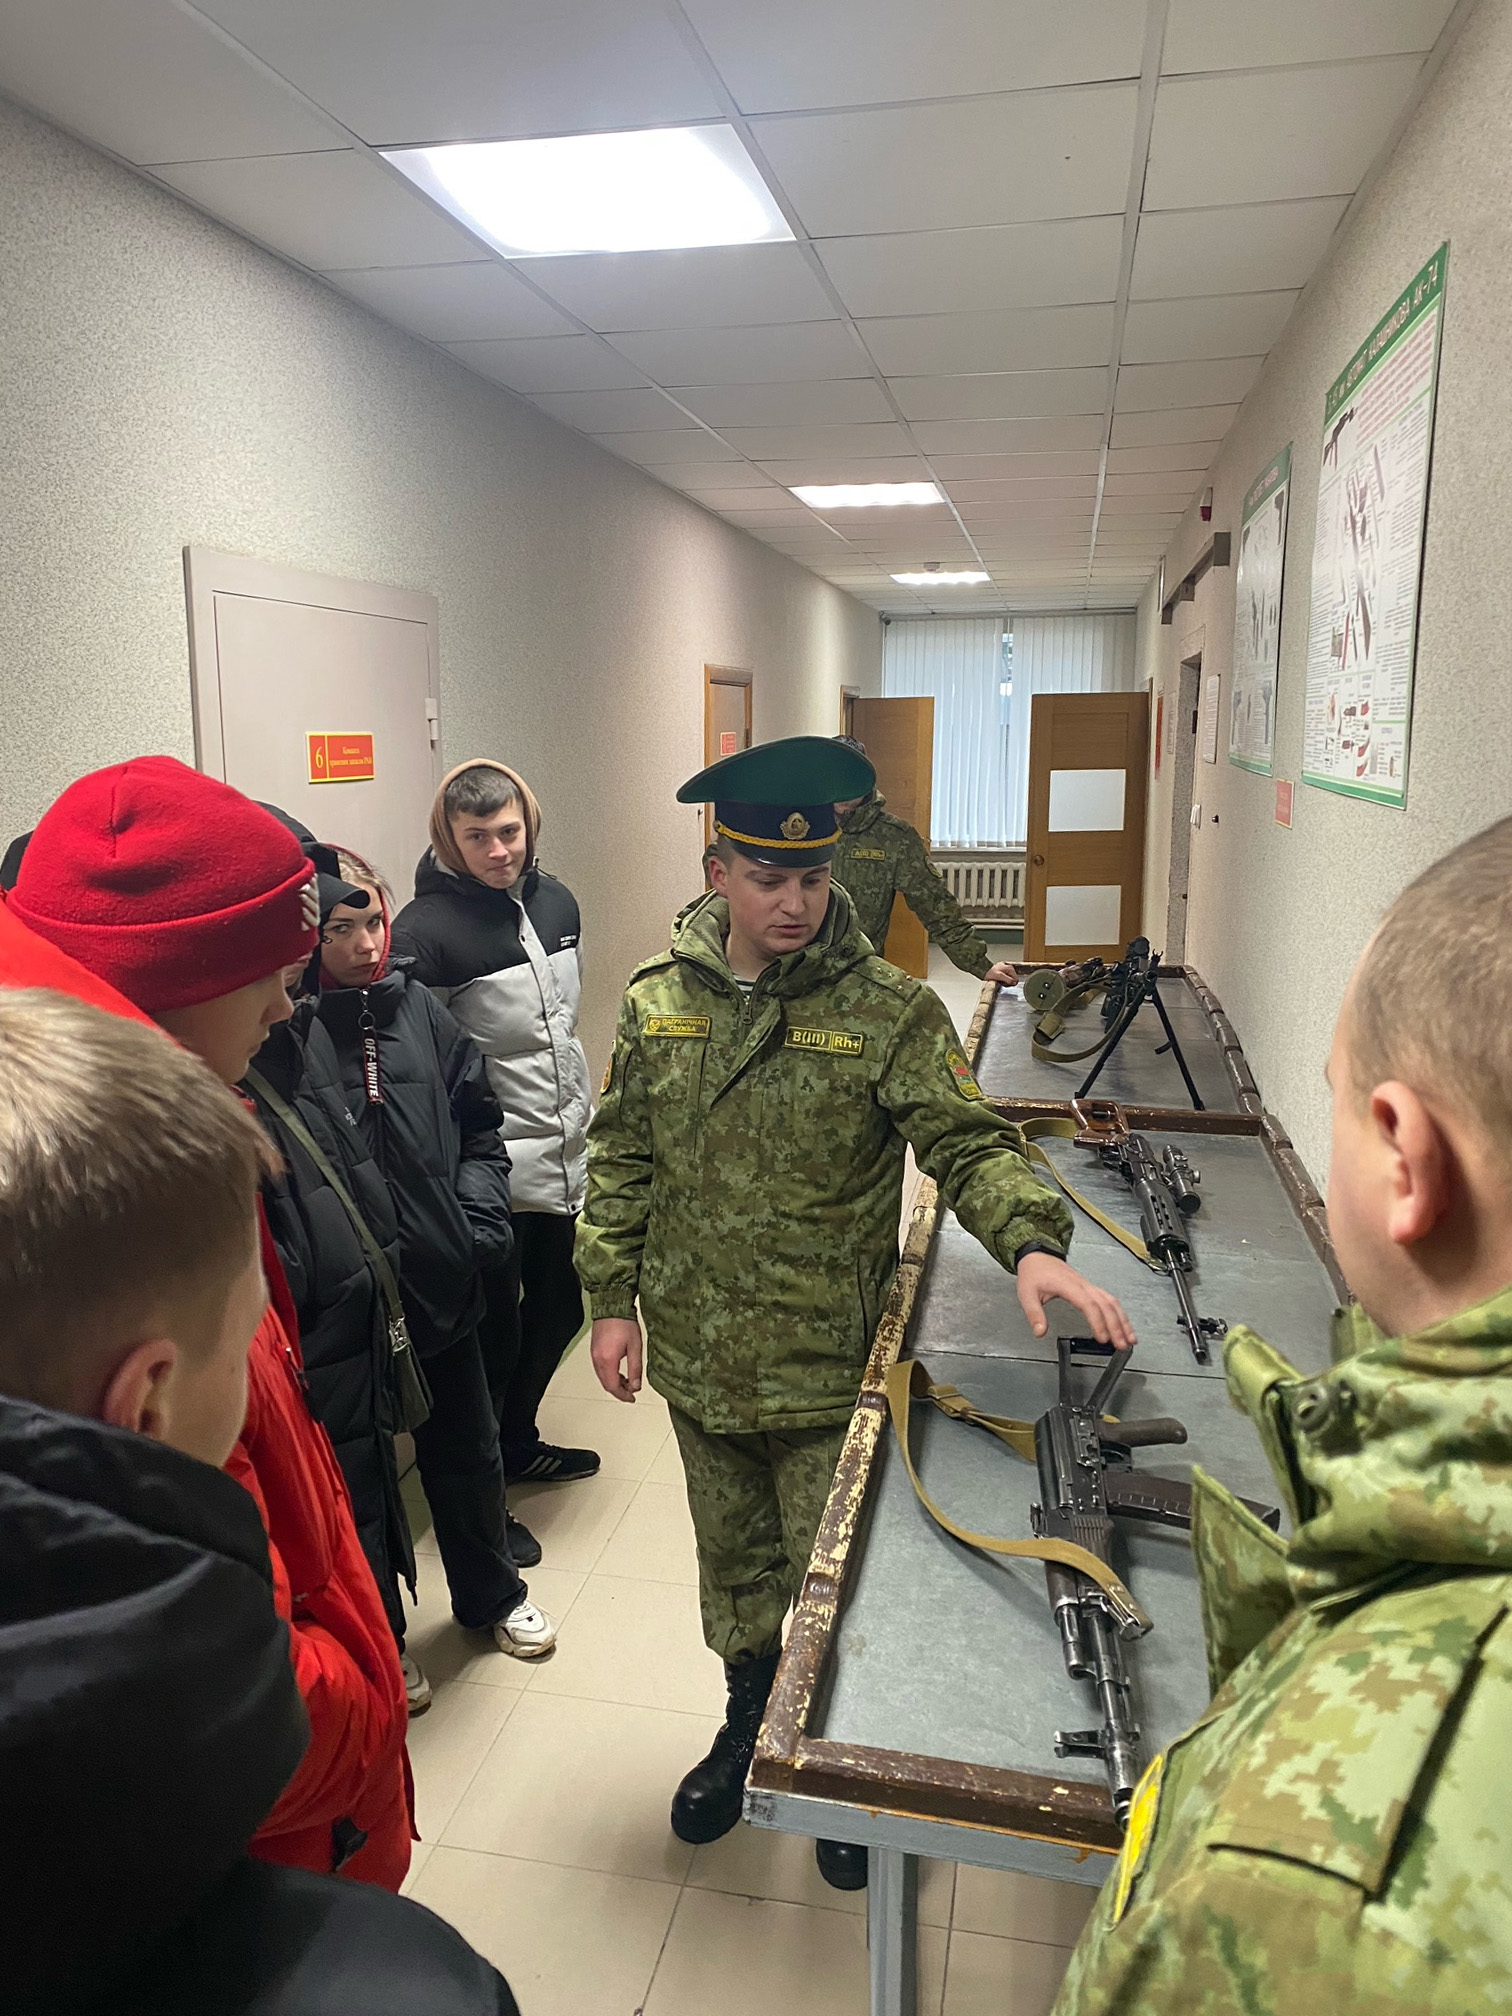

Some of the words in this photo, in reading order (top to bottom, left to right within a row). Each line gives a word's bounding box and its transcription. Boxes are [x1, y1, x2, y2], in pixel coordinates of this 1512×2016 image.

[315, 745, 324, 769] 6
[793, 1031, 825, 1046] B(III)
[834, 1035, 860, 1049] Rh+
[364, 1037, 379, 1098] OFF-WHITE
